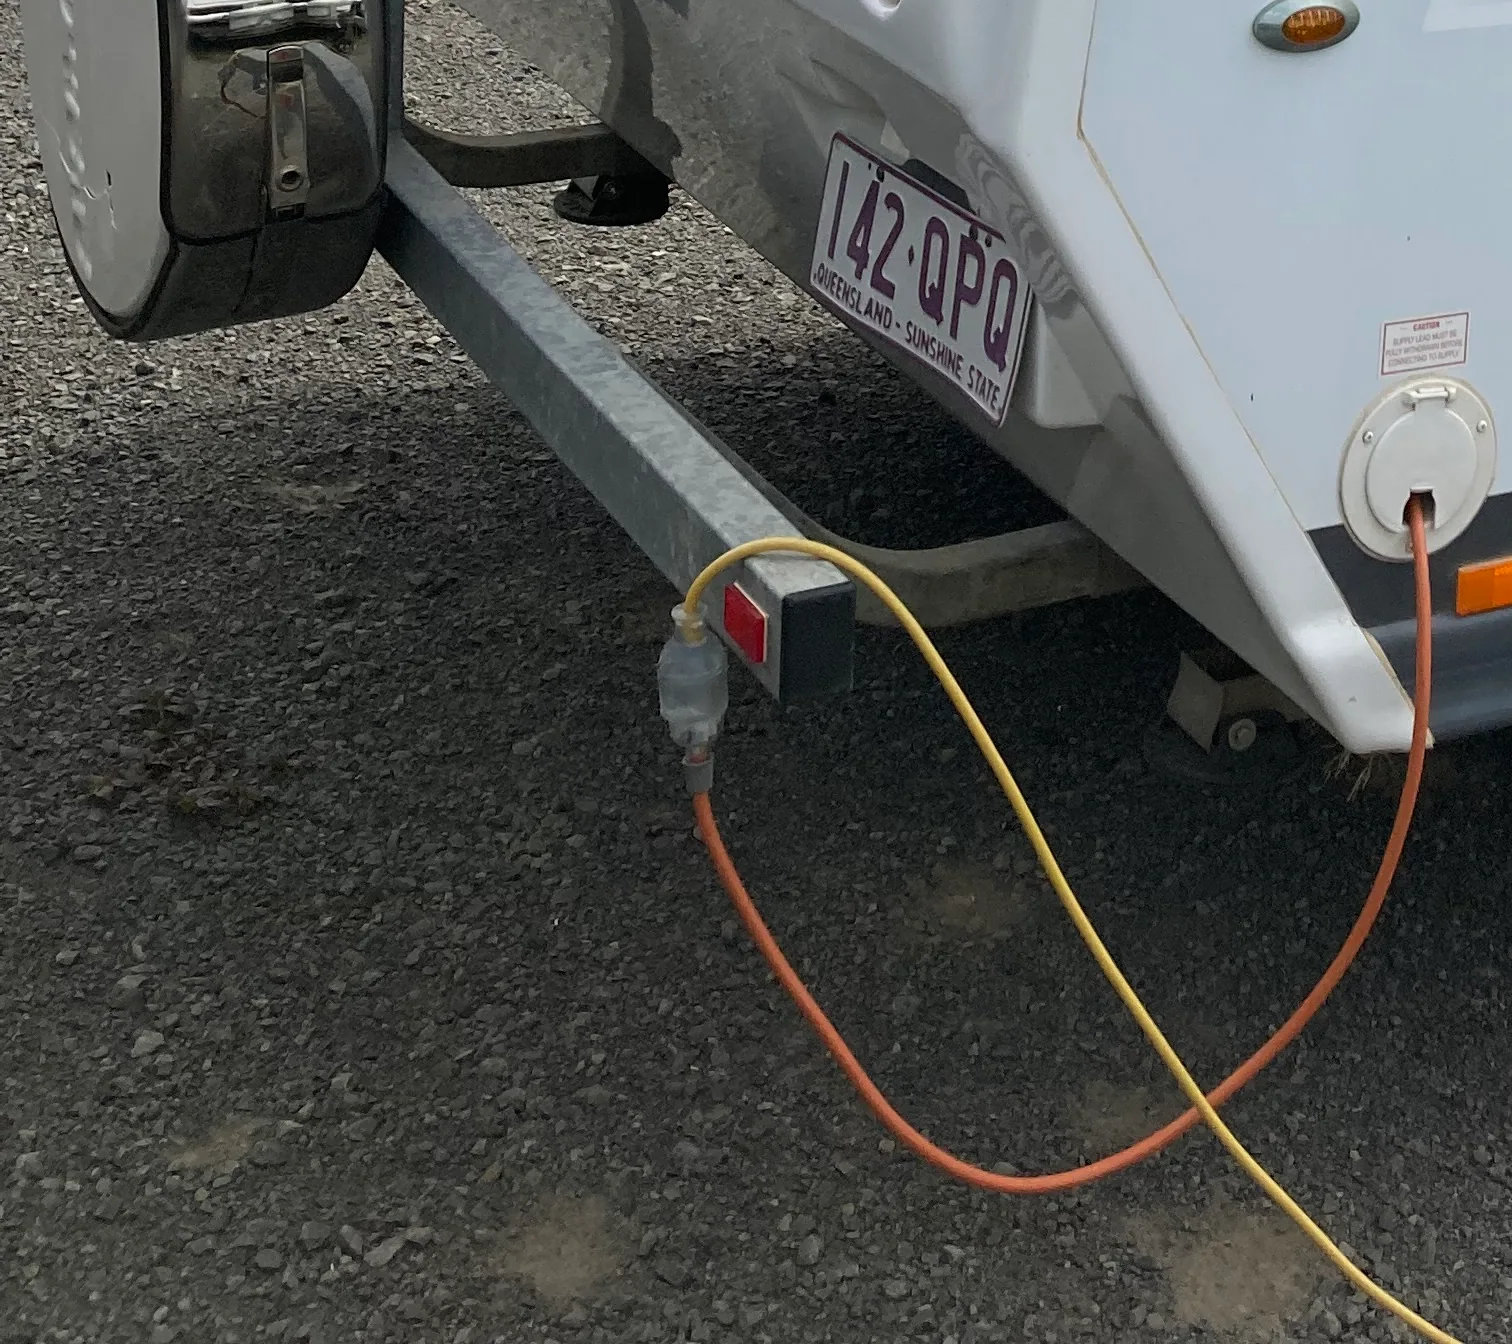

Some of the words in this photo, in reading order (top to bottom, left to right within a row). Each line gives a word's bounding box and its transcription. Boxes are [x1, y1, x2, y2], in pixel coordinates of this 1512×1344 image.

[817, 262, 893, 330] QUEENSLAND
[905, 320, 965, 380] SUNSHINE
[967, 363, 1002, 411] STATE
[1413, 321, 1440, 332] CAUTION
